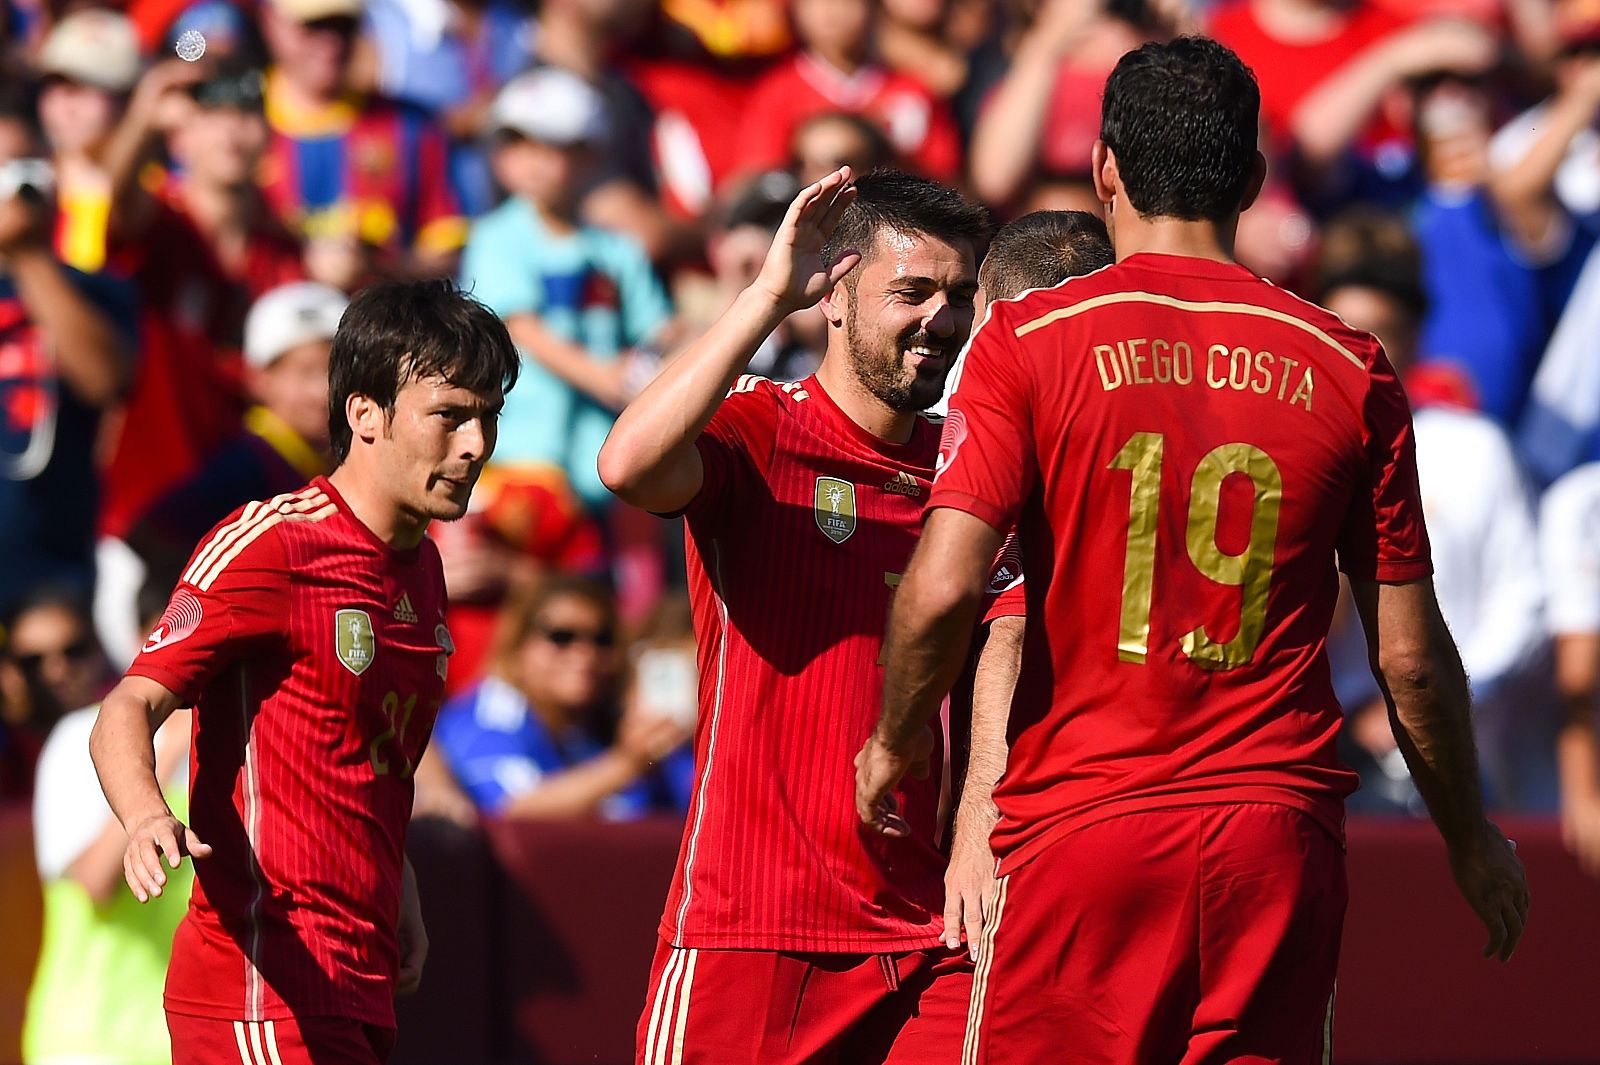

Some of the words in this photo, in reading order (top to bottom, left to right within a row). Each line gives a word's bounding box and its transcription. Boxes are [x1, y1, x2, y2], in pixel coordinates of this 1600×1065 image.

[1093, 338, 1194, 392] DIEGO
[1206, 344, 1315, 412] COSTA
[884, 480, 921, 496] adidas
[827, 517, 847, 529] FIFA
[1106, 431, 1283, 673] 19
[348, 649, 366, 658] FIFA
[370, 690, 417, 779] 21
